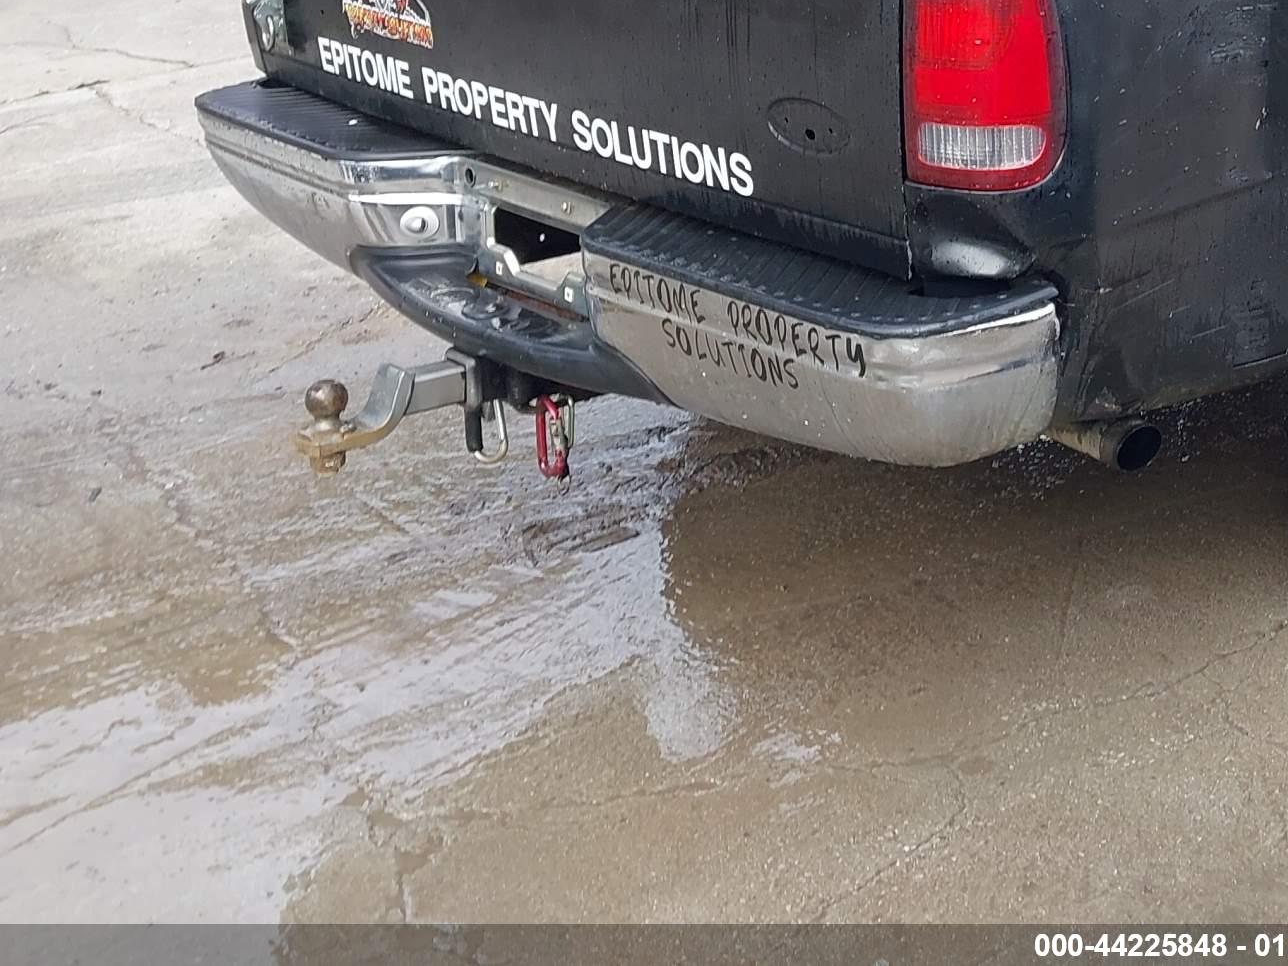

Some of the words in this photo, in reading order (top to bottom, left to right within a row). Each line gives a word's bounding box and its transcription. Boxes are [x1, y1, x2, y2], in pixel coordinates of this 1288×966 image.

[318, 36, 414, 100] EPITOME
[422, 67, 558, 142] PROPERTY
[571, 109, 755, 197] SOLUTIONS
[609, 262, 706, 325] EPITOME
[727, 300, 867, 379] PROPERTY
[661, 317, 799, 389] SOLUTIONS
